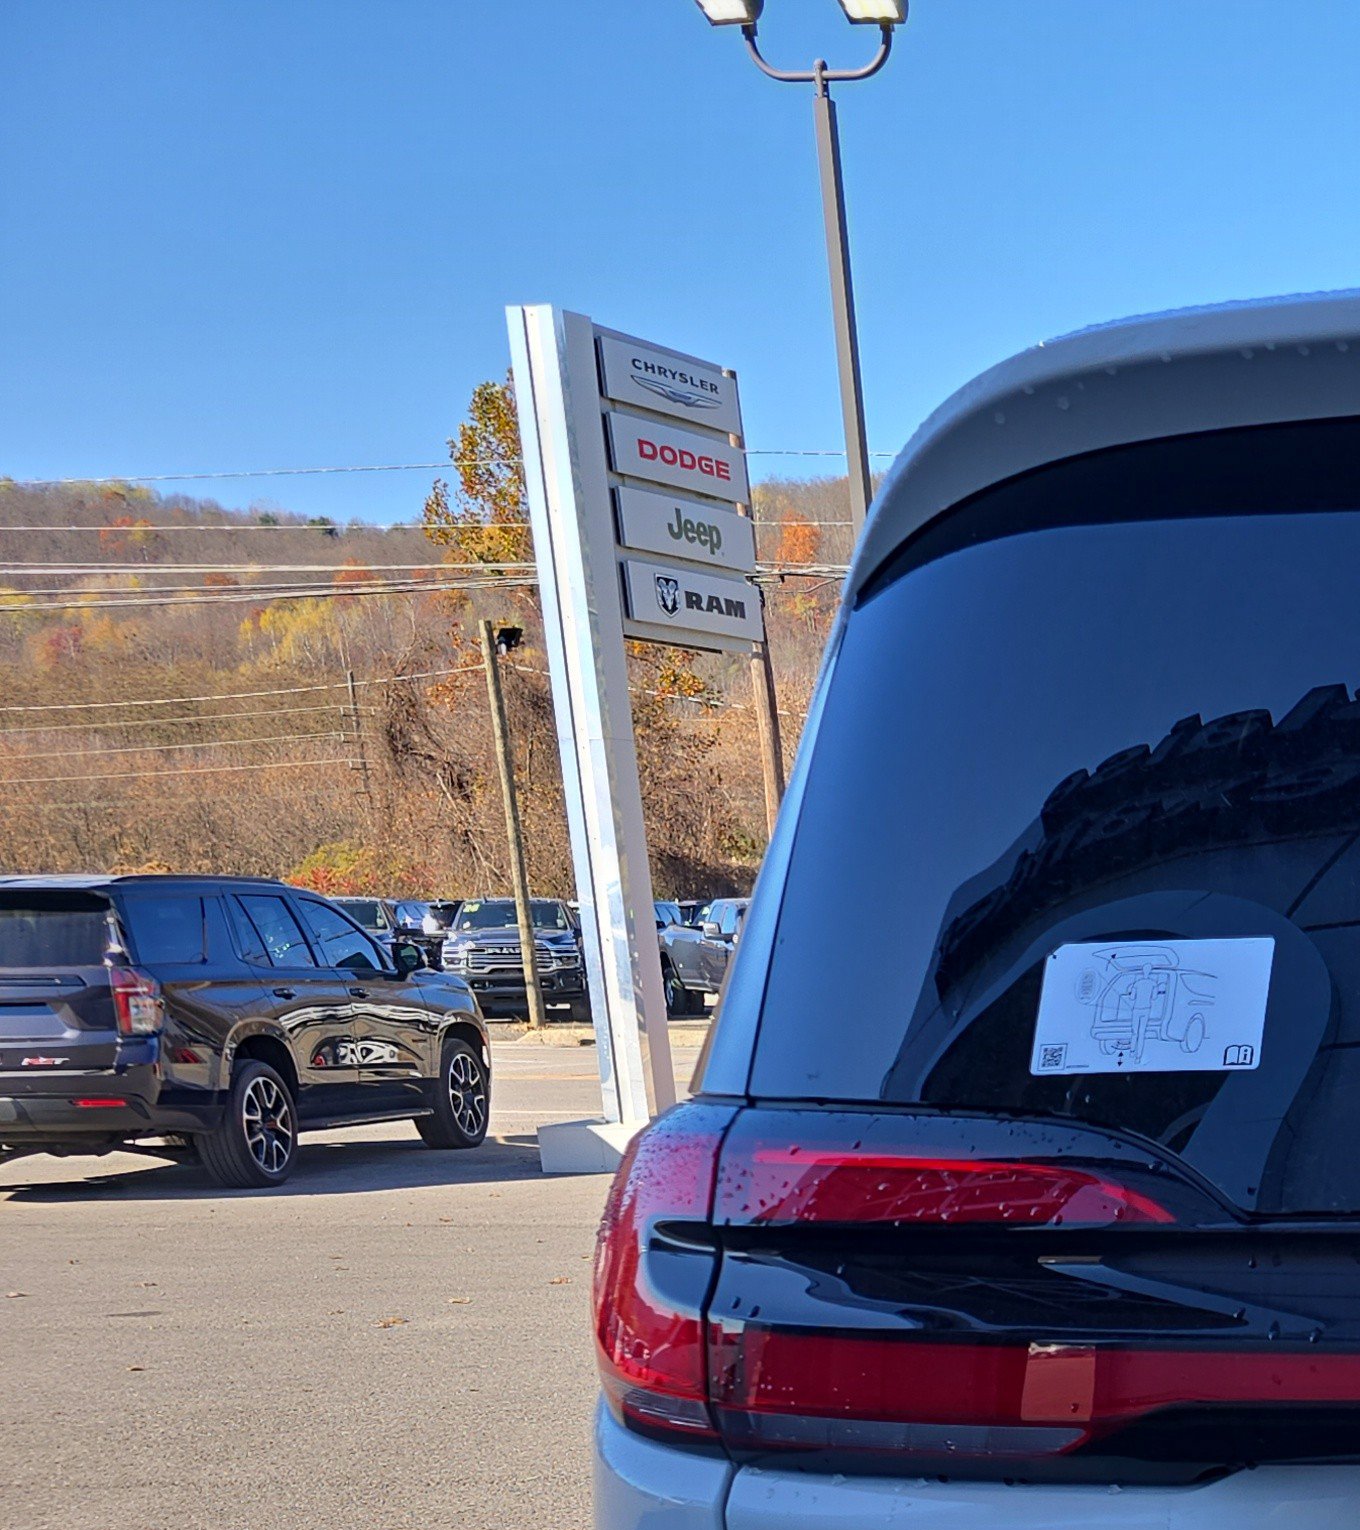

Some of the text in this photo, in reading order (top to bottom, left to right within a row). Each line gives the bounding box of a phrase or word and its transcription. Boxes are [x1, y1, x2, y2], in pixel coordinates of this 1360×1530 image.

[631, 358, 719, 395] CHRYSLER
[637, 438, 731, 481] DODGE
[667, 507, 722, 555] Jeep
[685, 590, 746, 619] RAM
